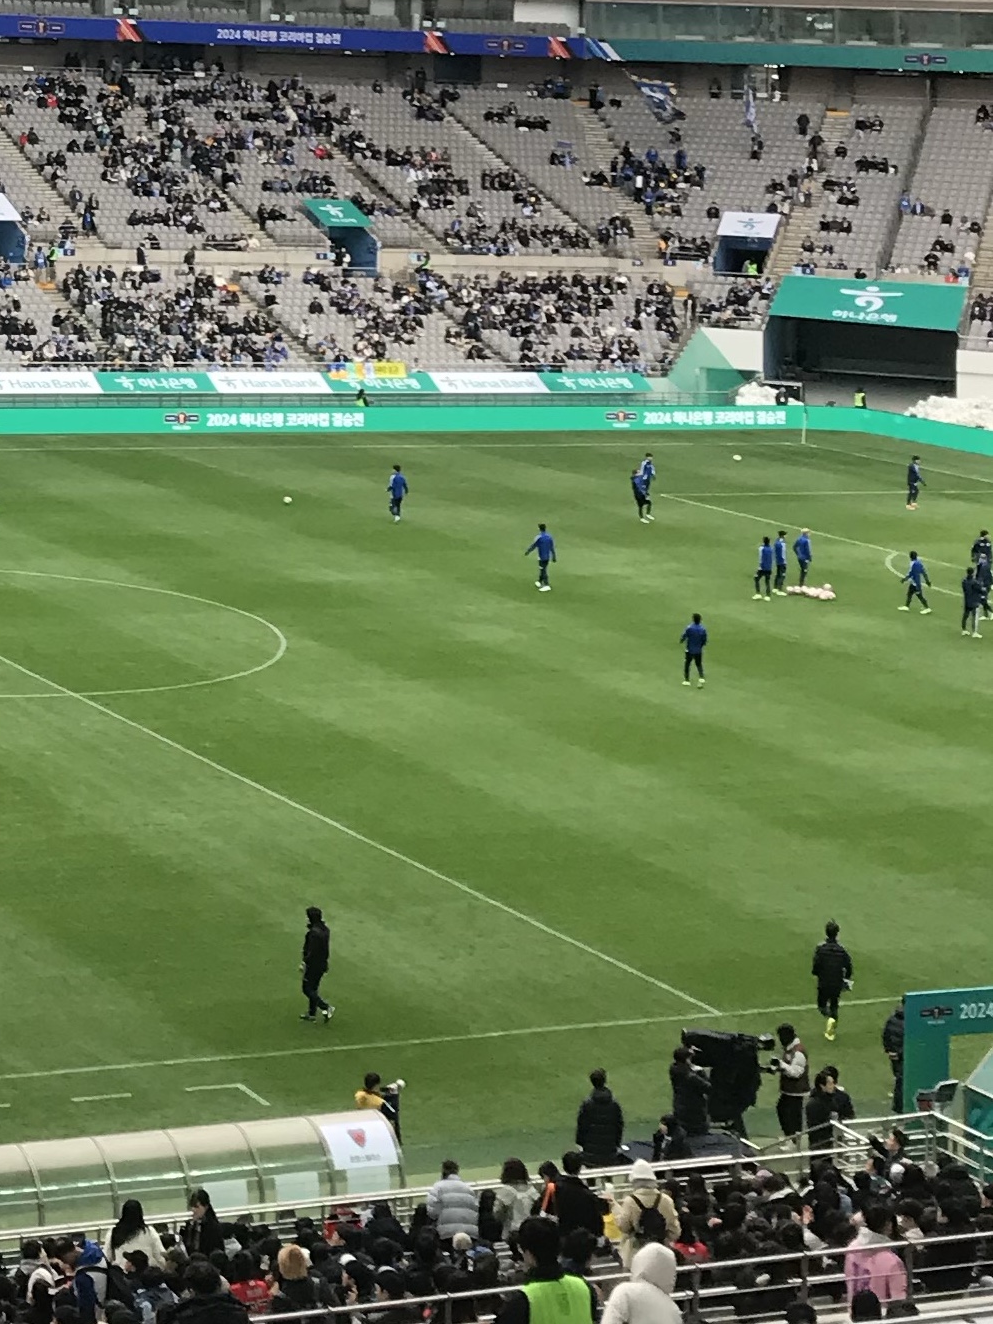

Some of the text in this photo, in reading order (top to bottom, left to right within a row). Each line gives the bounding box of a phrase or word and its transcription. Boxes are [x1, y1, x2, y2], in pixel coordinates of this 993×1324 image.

[217, 28, 241, 40] 2024
[9, 378, 91, 389] Hana Bank
[206, 413, 238, 427] 2024
[643, 411, 672, 425] 2024
